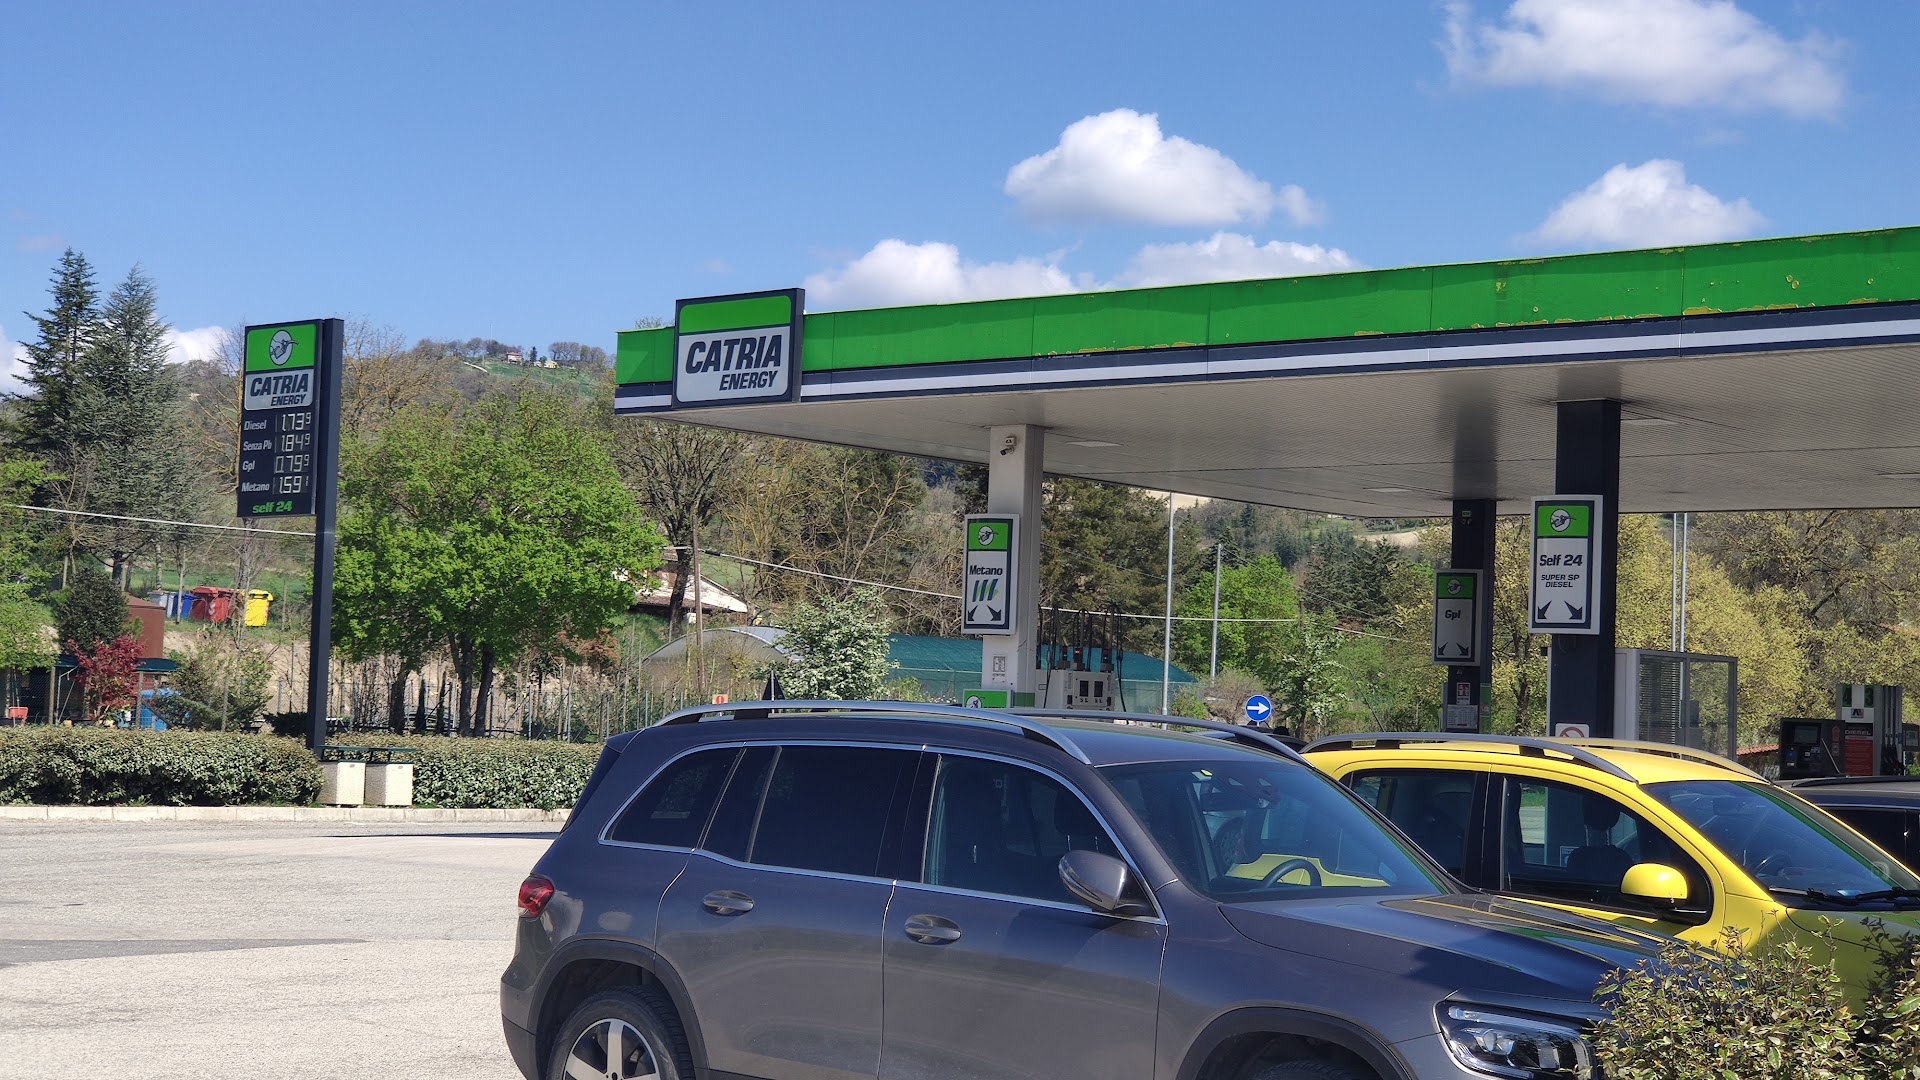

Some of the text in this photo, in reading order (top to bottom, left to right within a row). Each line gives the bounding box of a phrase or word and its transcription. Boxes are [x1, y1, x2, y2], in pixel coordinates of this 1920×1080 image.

[686, 334, 782, 374] CATRIA
[250, 374, 309, 397] CATRIA
[719, 370, 778, 391] ENERGY
[271, 394, 306, 406] ENERGY
[244, 420, 267, 430] Diesel
[243, 440, 262, 451] Senza
[263, 440, 272, 450] Pb
[242, 460, 255, 472] Gpl
[241, 482, 270, 492] Metano
[252, 500, 293, 514] self 24
[1539, 554, 1583, 566] Self 24
[969, 564, 1003, 576] Metano
[1444, 609, 1462, 620] Gpl
